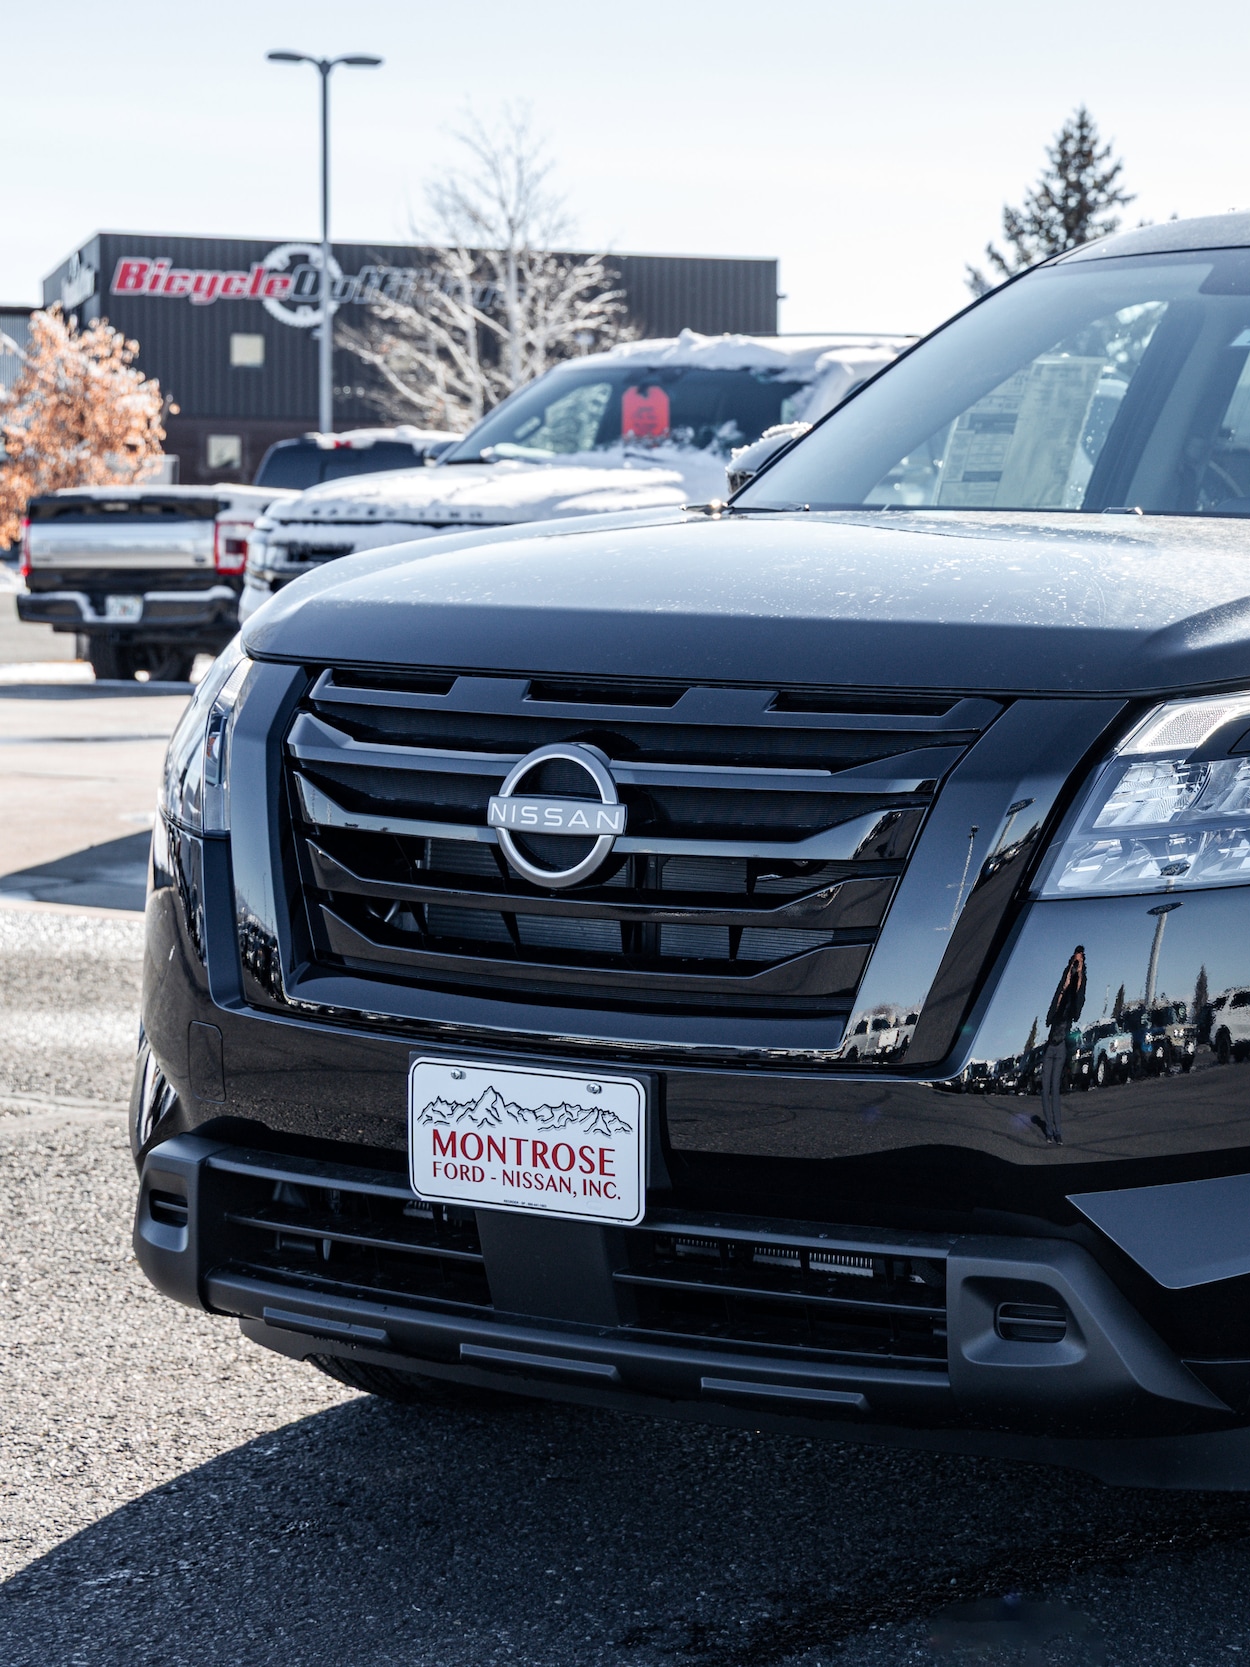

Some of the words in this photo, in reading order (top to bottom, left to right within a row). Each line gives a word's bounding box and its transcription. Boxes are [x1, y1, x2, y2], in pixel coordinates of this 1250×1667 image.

[110, 257, 293, 305] Bicycle
[490, 803, 620, 830] NISSAN
[432, 1128, 616, 1177] MONTROSE
[432, 1161, 485, 1183] FORD
[502, 1169, 577, 1198] NISSAN,
[582, 1178, 622, 1200] INC.
